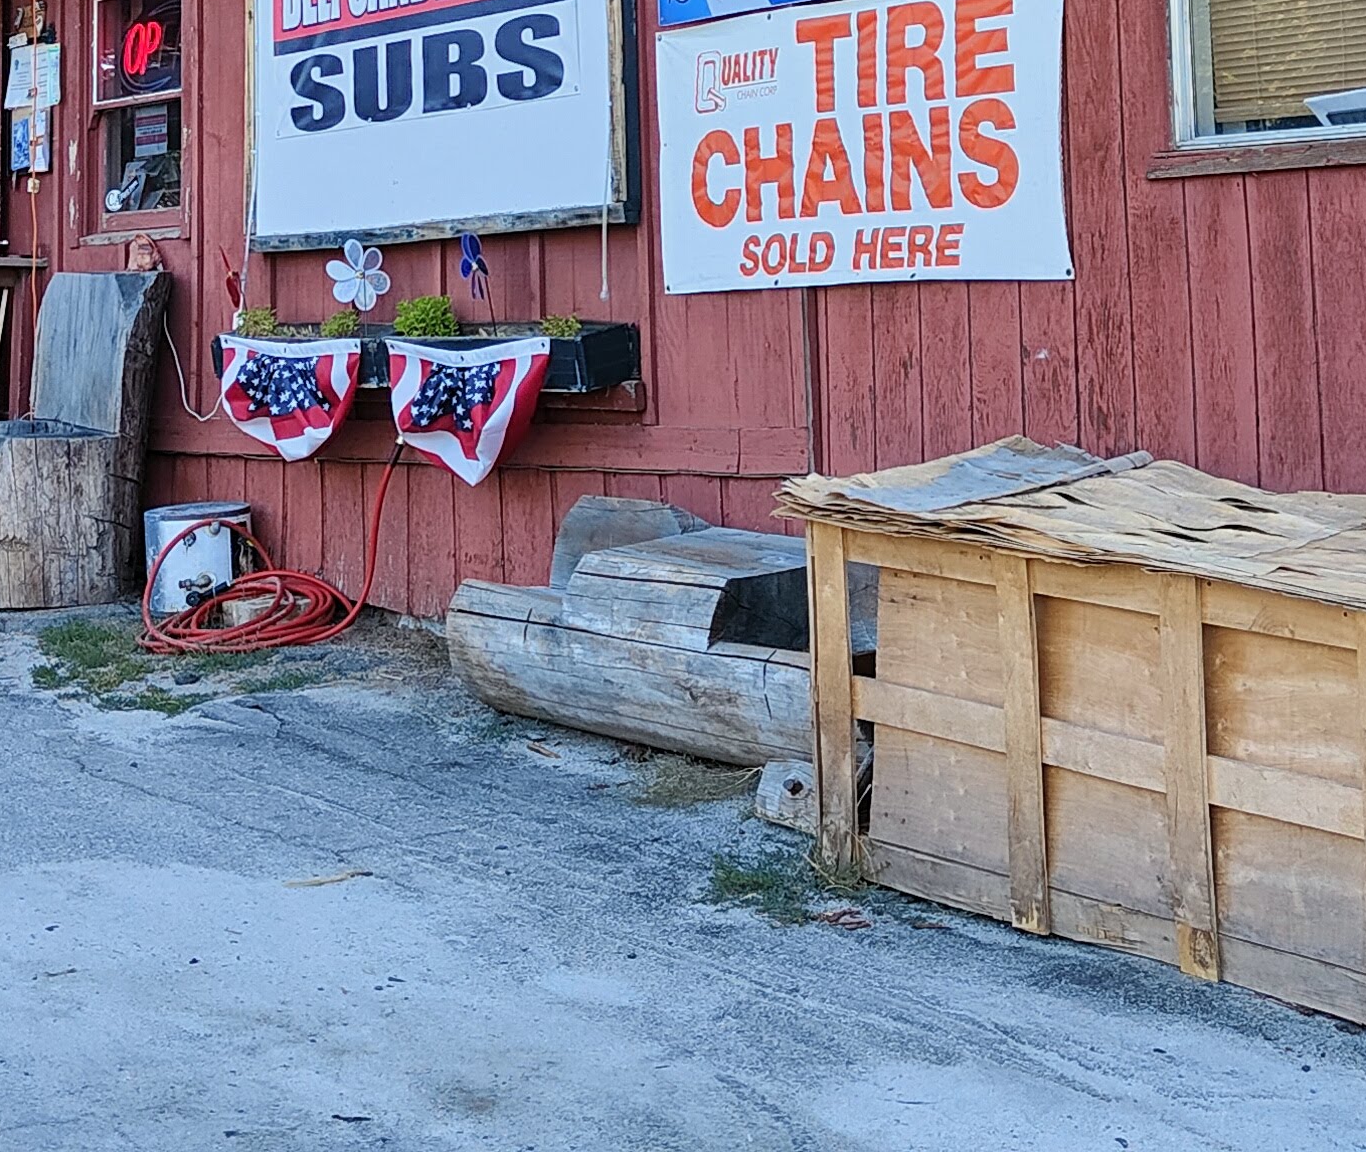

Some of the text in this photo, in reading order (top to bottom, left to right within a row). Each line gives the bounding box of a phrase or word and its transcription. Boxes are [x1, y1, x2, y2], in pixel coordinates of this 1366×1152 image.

[290, 13, 565, 133] SUBS
[696, 47, 779, 114] QUALITY
[691, 98, 1020, 228] CHAINS
[740, 223, 965, 277] SOLD HERE
